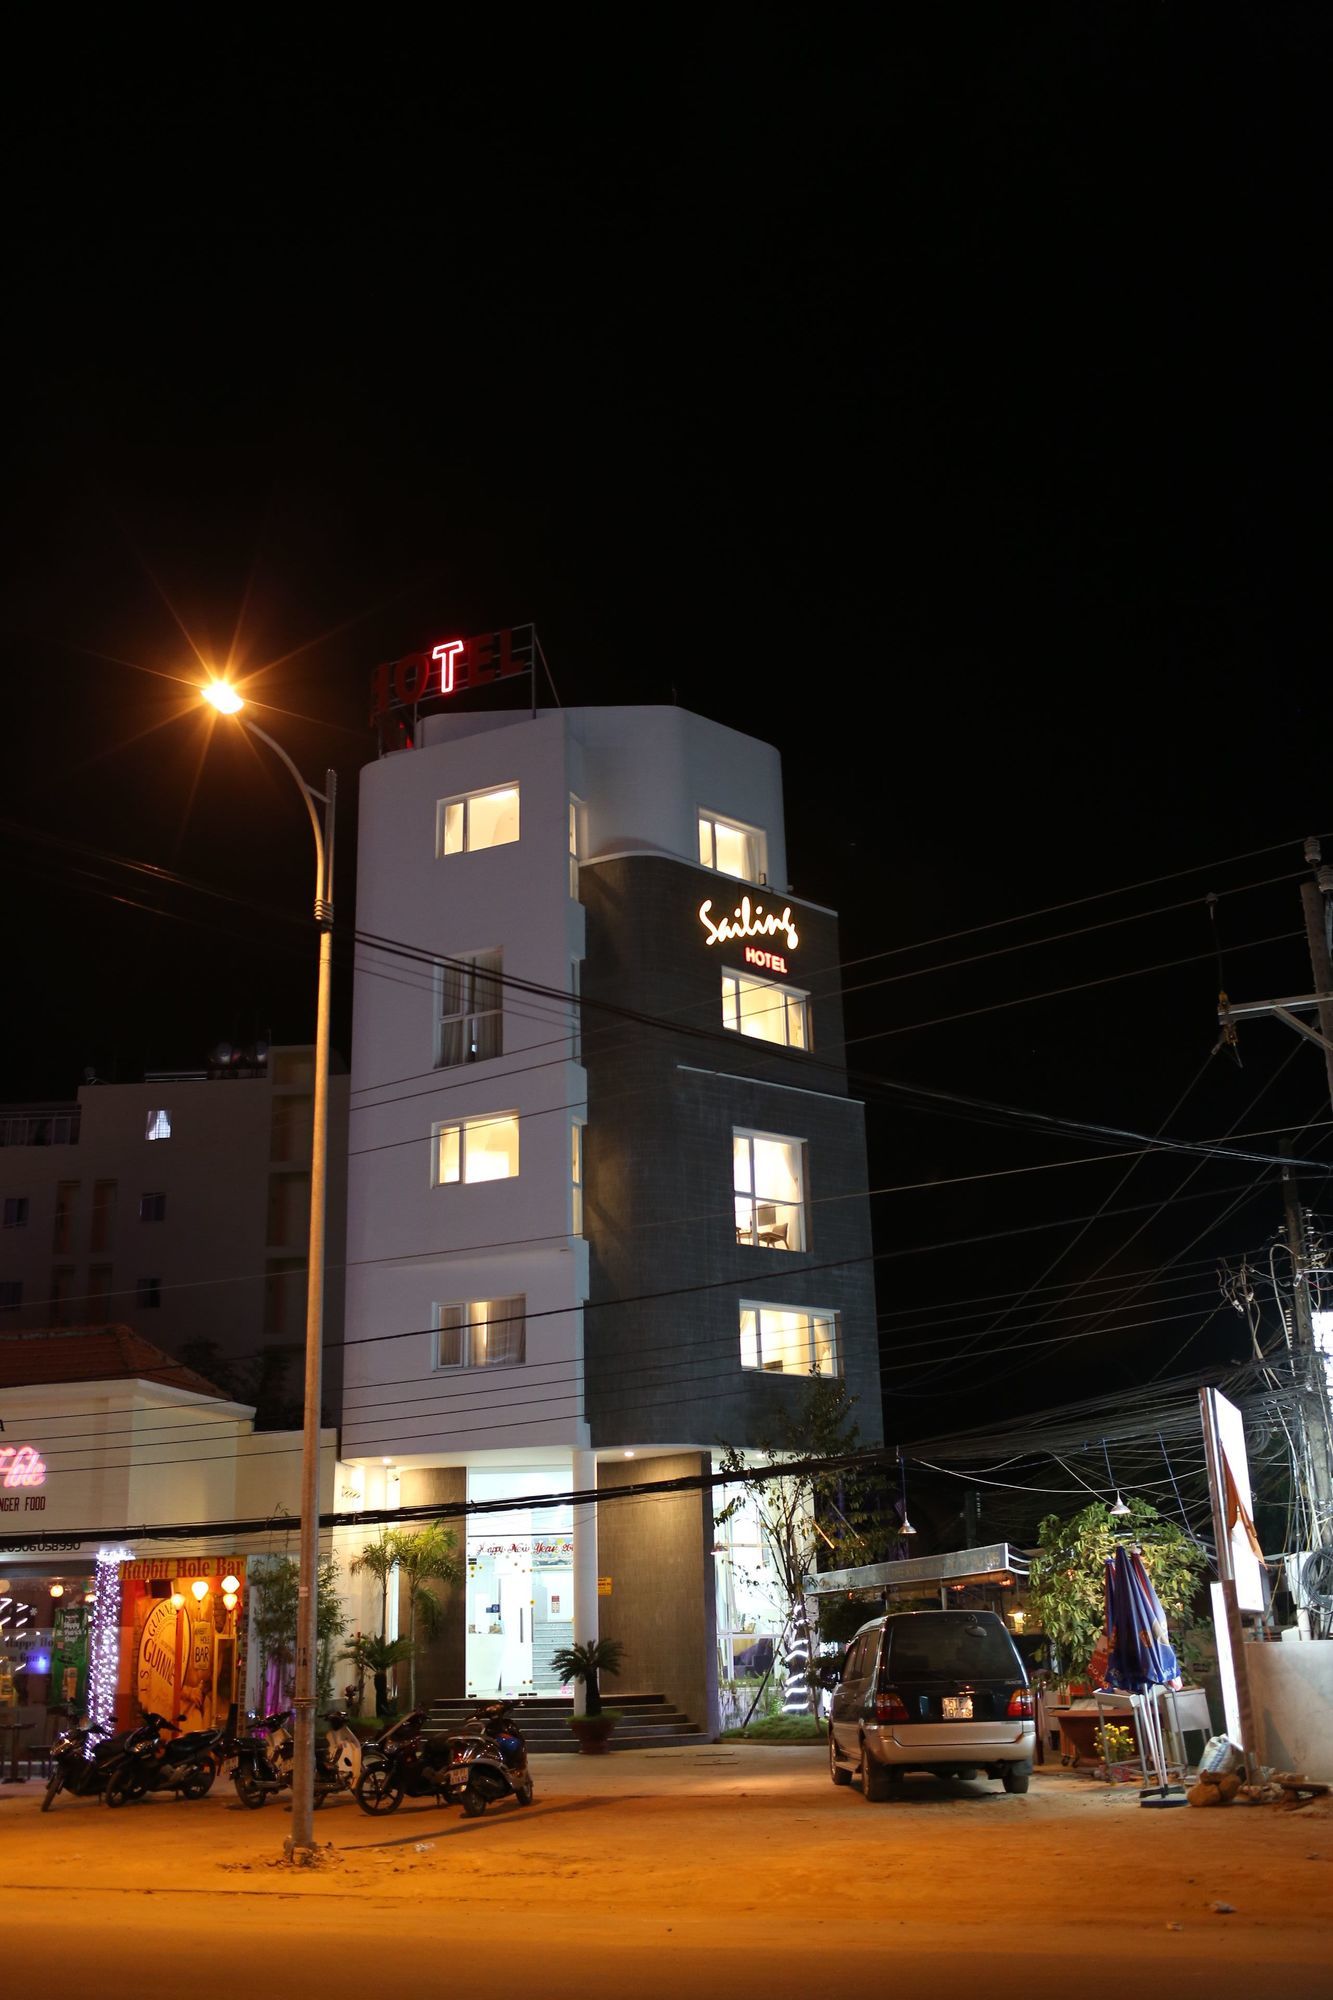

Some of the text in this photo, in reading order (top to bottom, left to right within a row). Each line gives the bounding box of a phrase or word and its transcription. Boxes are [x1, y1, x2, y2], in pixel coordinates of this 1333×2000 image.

[699, 896, 799, 950] Sailing
[745, 947, 788, 974] HOTEL
[25, 1496, 46, 1511] FOOD
[176, 1556, 210, 1578] Hole
[216, 1554, 244, 1576] Bar
[194, 1646, 209, 1663] BAR
